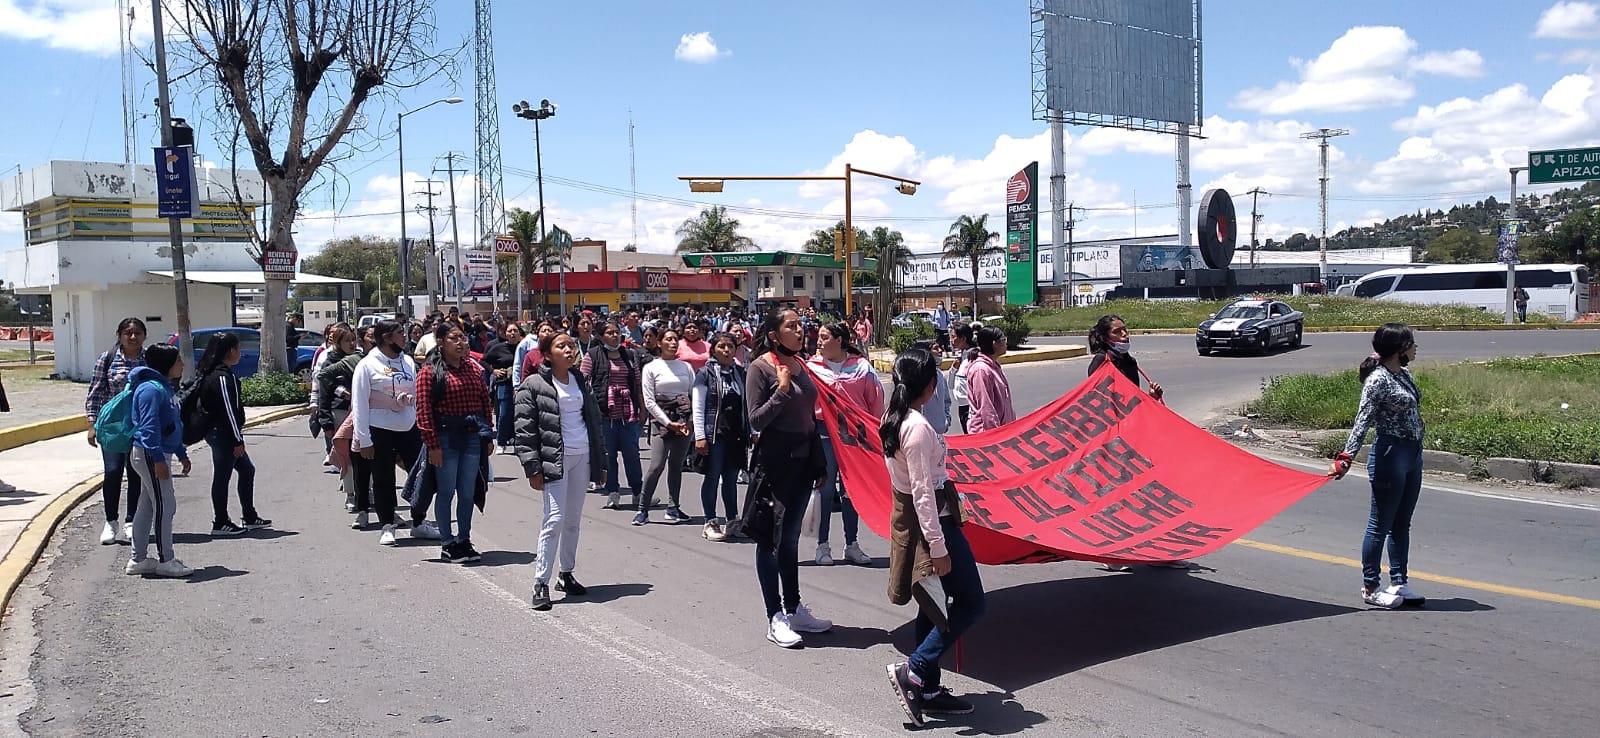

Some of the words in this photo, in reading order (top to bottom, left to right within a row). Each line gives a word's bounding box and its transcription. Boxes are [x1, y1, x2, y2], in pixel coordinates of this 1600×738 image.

[1559, 154, 1565, 164] T
[1567, 153, 1580, 164] DE
[1583, 152, 1600, 163] AUT
[1008, 203, 1032, 213] PEMEX
[496, 240, 520, 252] OXXO
[722, 255, 756, 263] PEMEX
[941, 260, 956, 270] LAS
[958, 256, 1002, 269] CEEZAS
[1064, 250, 1109, 263] LTIPLANO
[647, 273, 668, 287] OXXO
[946, 376, 1142, 484] SEPTIEMBRE
[1002, 436, 1154, 523] OLVIDA
[1057, 480, 1196, 549] LUCHA
[1098, 521, 1233, 560] TIVA
